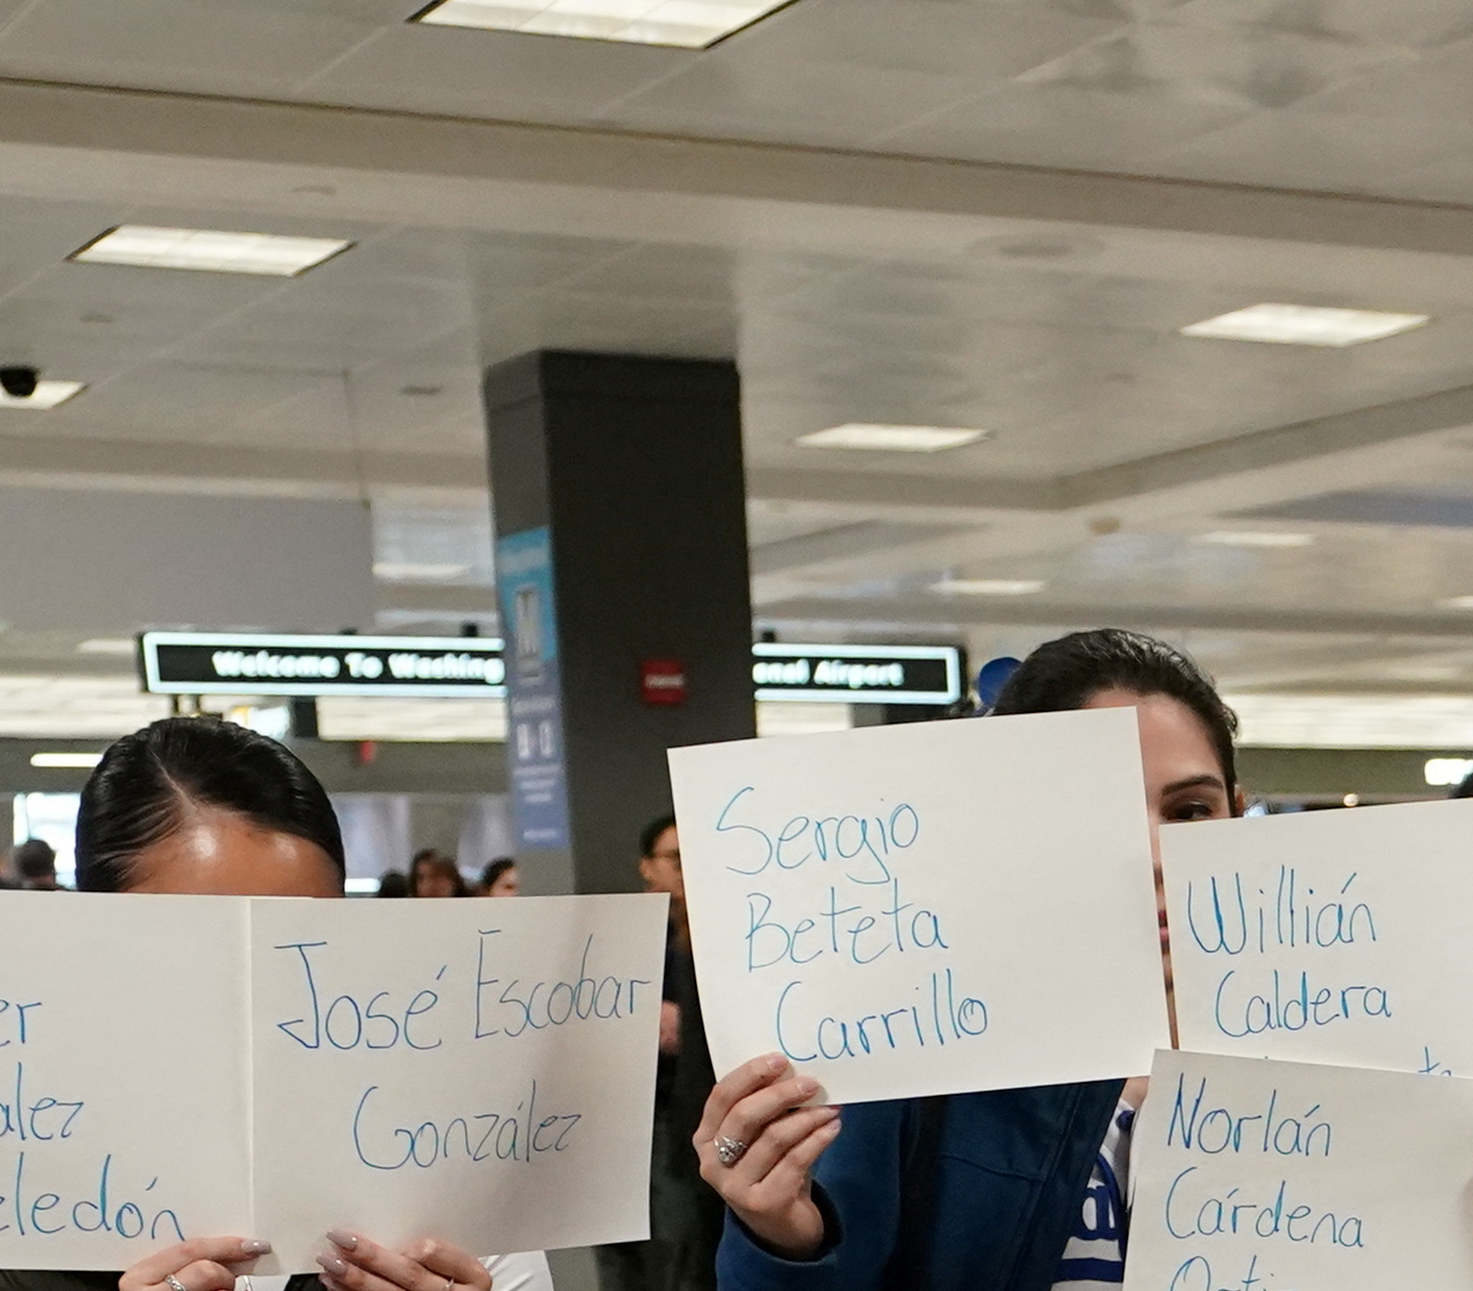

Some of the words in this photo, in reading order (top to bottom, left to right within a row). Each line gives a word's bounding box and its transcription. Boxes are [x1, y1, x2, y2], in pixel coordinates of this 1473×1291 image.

[211, 650, 341, 678] Welcome
[388, 653, 505, 684] Washing
[813, 659, 904, 689] Airport
[716, 786, 920, 885] Sergio
[745, 878, 949, 973] Beteta
[1188, 864, 1376, 955] Willián
[273, 941, 448, 1051] José
[475, 929, 652, 1039] Escobar
[776, 968, 988, 1063] Carrillo
[1215, 969, 1392, 1038] Caldera
[354, 1079, 582, 1170] González
[1167, 1071, 1331, 1157] Norlán
[1165, 1165, 1365, 1249] Cárdena
